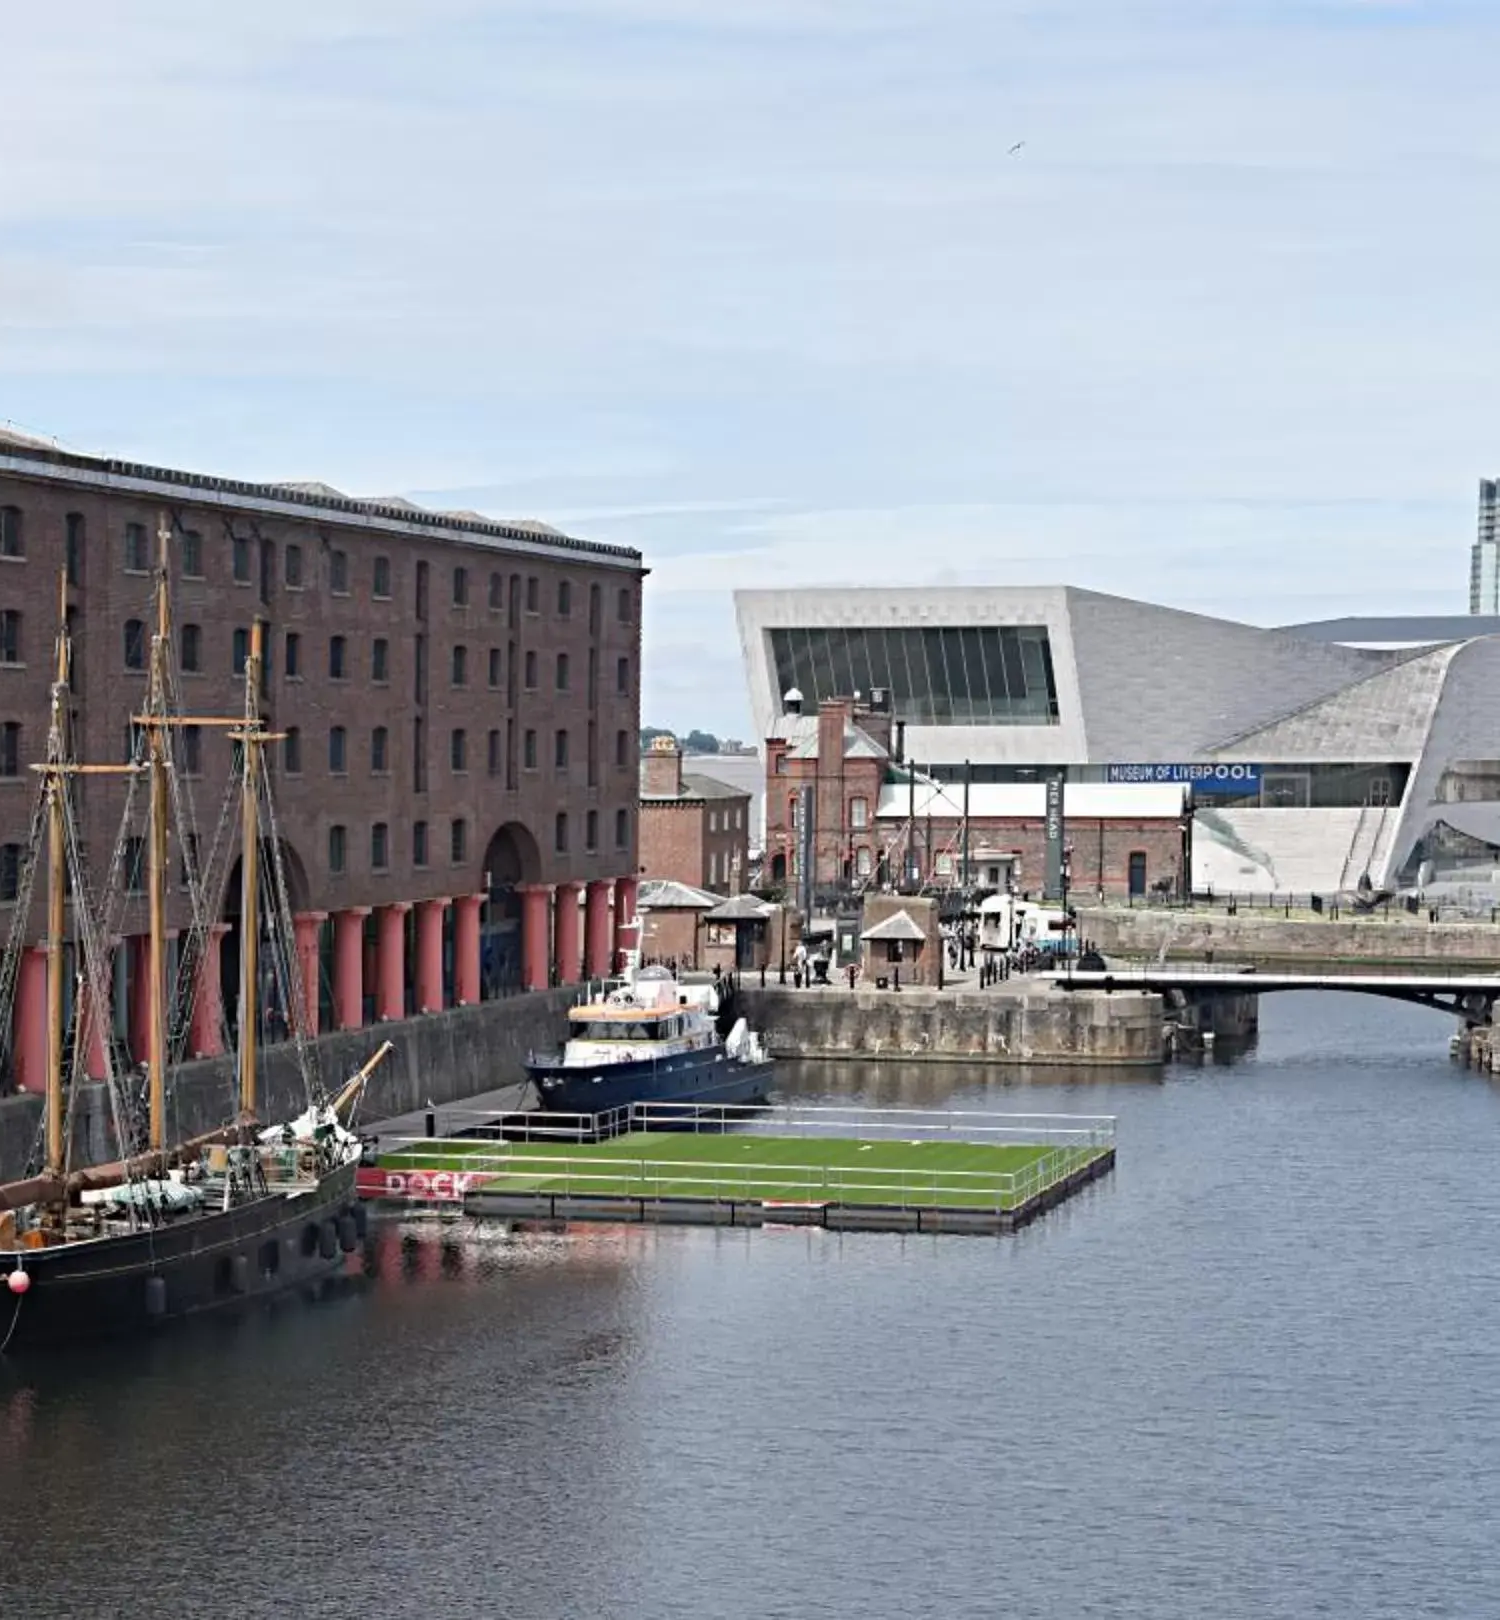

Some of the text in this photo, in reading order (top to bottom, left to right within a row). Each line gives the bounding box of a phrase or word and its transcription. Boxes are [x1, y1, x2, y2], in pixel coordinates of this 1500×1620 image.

[1110, 765, 1257, 781] MUSEUM OF LIVERPOOL
[1049, 781, 1059, 839] PIER HEAD
[386, 1172, 473, 1197] DOCK
